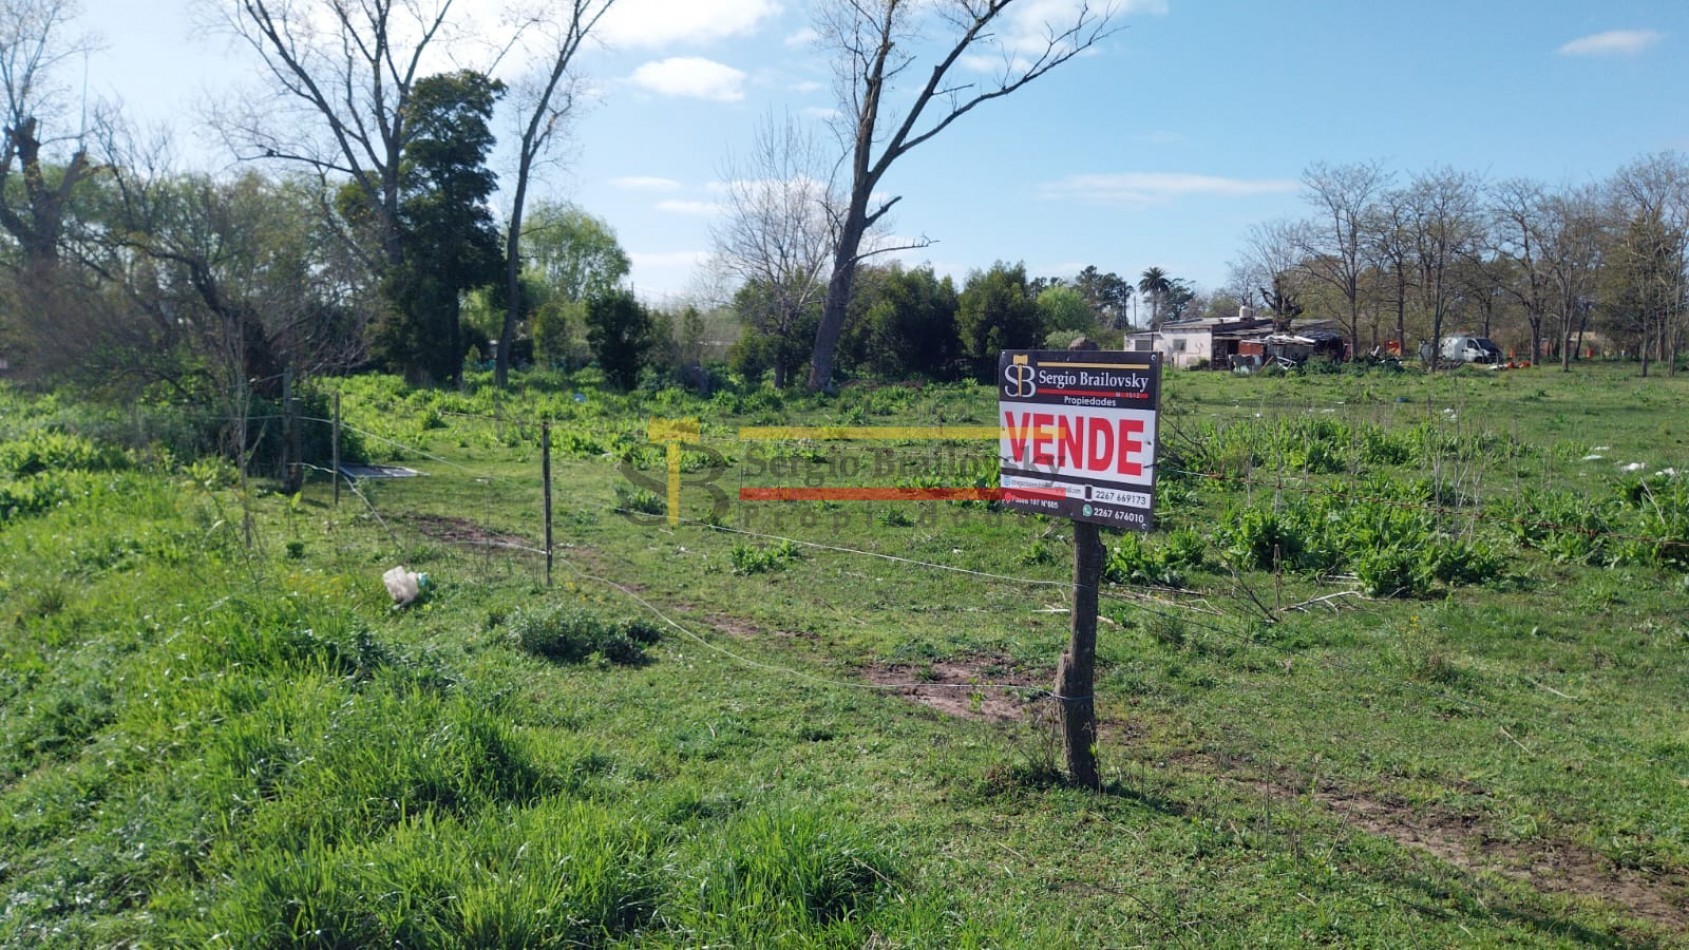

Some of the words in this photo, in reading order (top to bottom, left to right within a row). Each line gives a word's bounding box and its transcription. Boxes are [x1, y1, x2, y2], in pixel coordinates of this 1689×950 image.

[1039, 370, 1076, 389] Sergio
[1080, 371, 1149, 393] Brailovsky
[1064, 396, 1117, 407] Propiedades
[1004, 411, 1144, 477] VENDE
[1095, 490, 1115, 500] 2267
[1116, 492, 1147, 506] 669173
[1093, 507, 1113, 517] 2267
[1114, 509, 1144, 524] 676010
